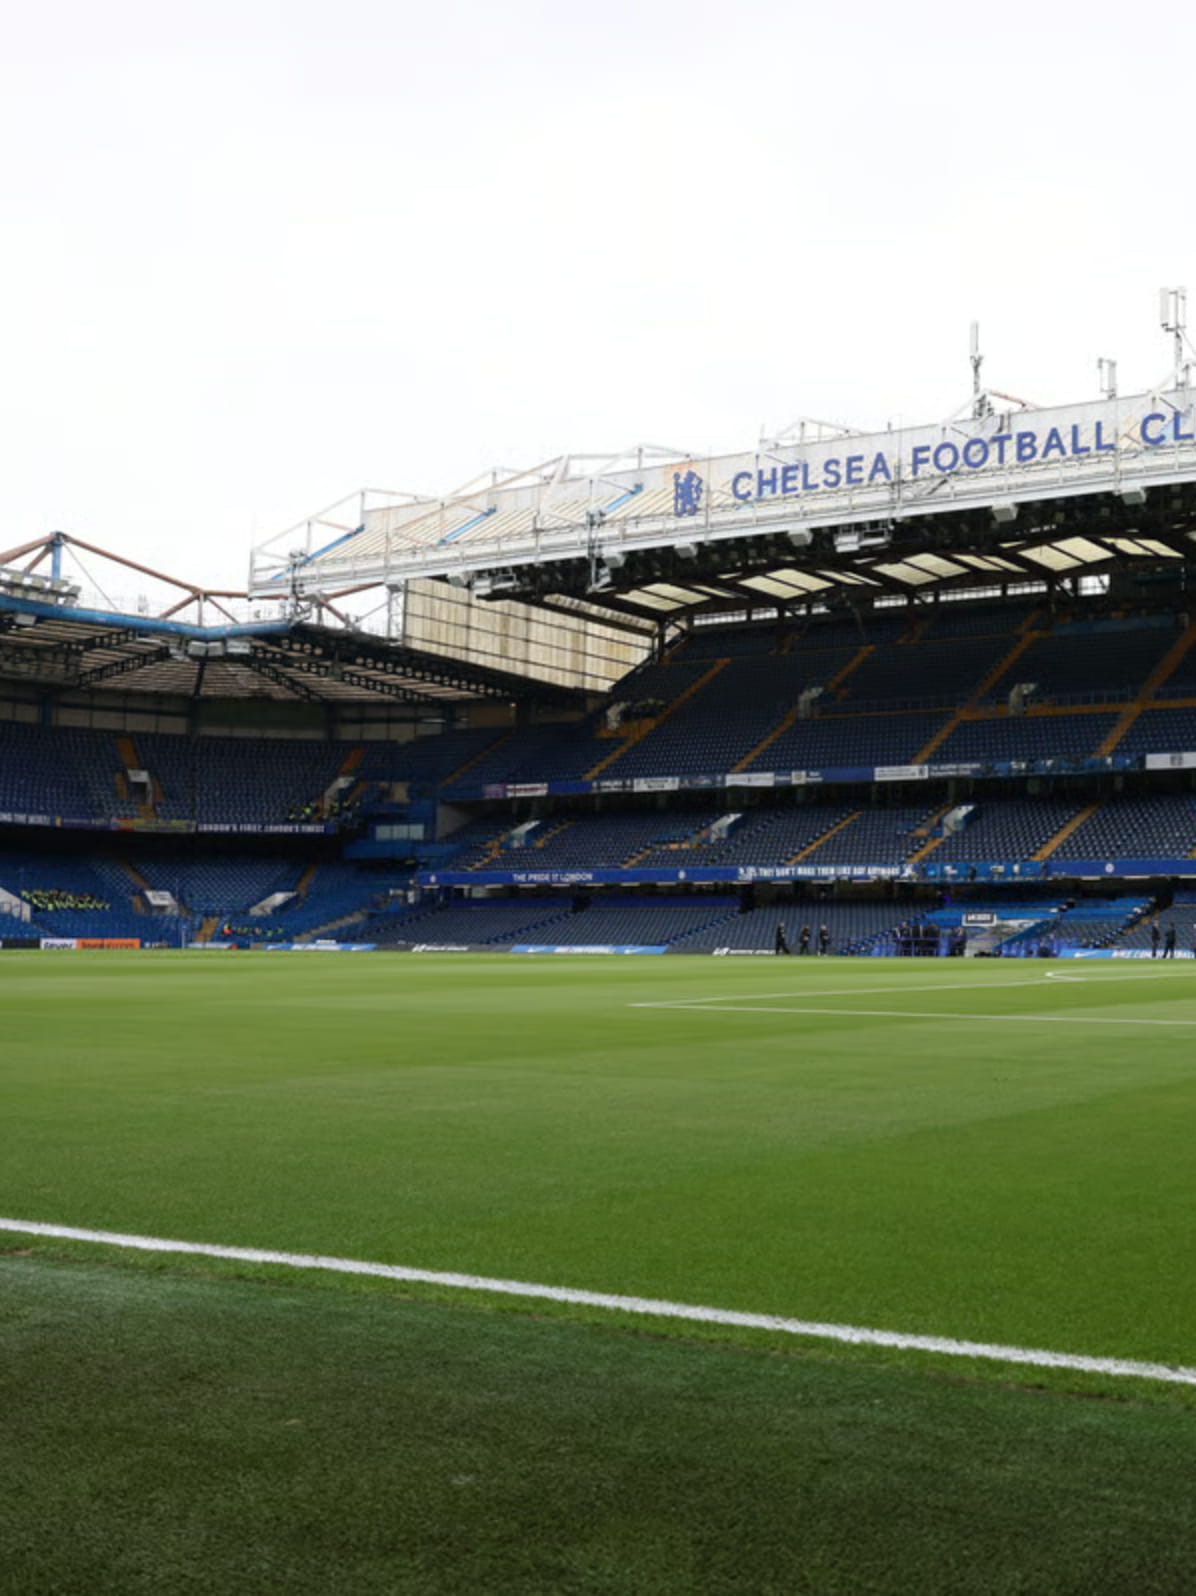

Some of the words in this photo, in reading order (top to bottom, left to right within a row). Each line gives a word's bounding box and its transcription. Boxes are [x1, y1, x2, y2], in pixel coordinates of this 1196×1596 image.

[732, 452, 893, 500] CHELSEA
[911, 421, 1115, 475] FOOTBALL
[513, 873, 526, 882] THE
[528, 873, 550, 882] PRIDE
[560, 872, 593, 882] LONDON
